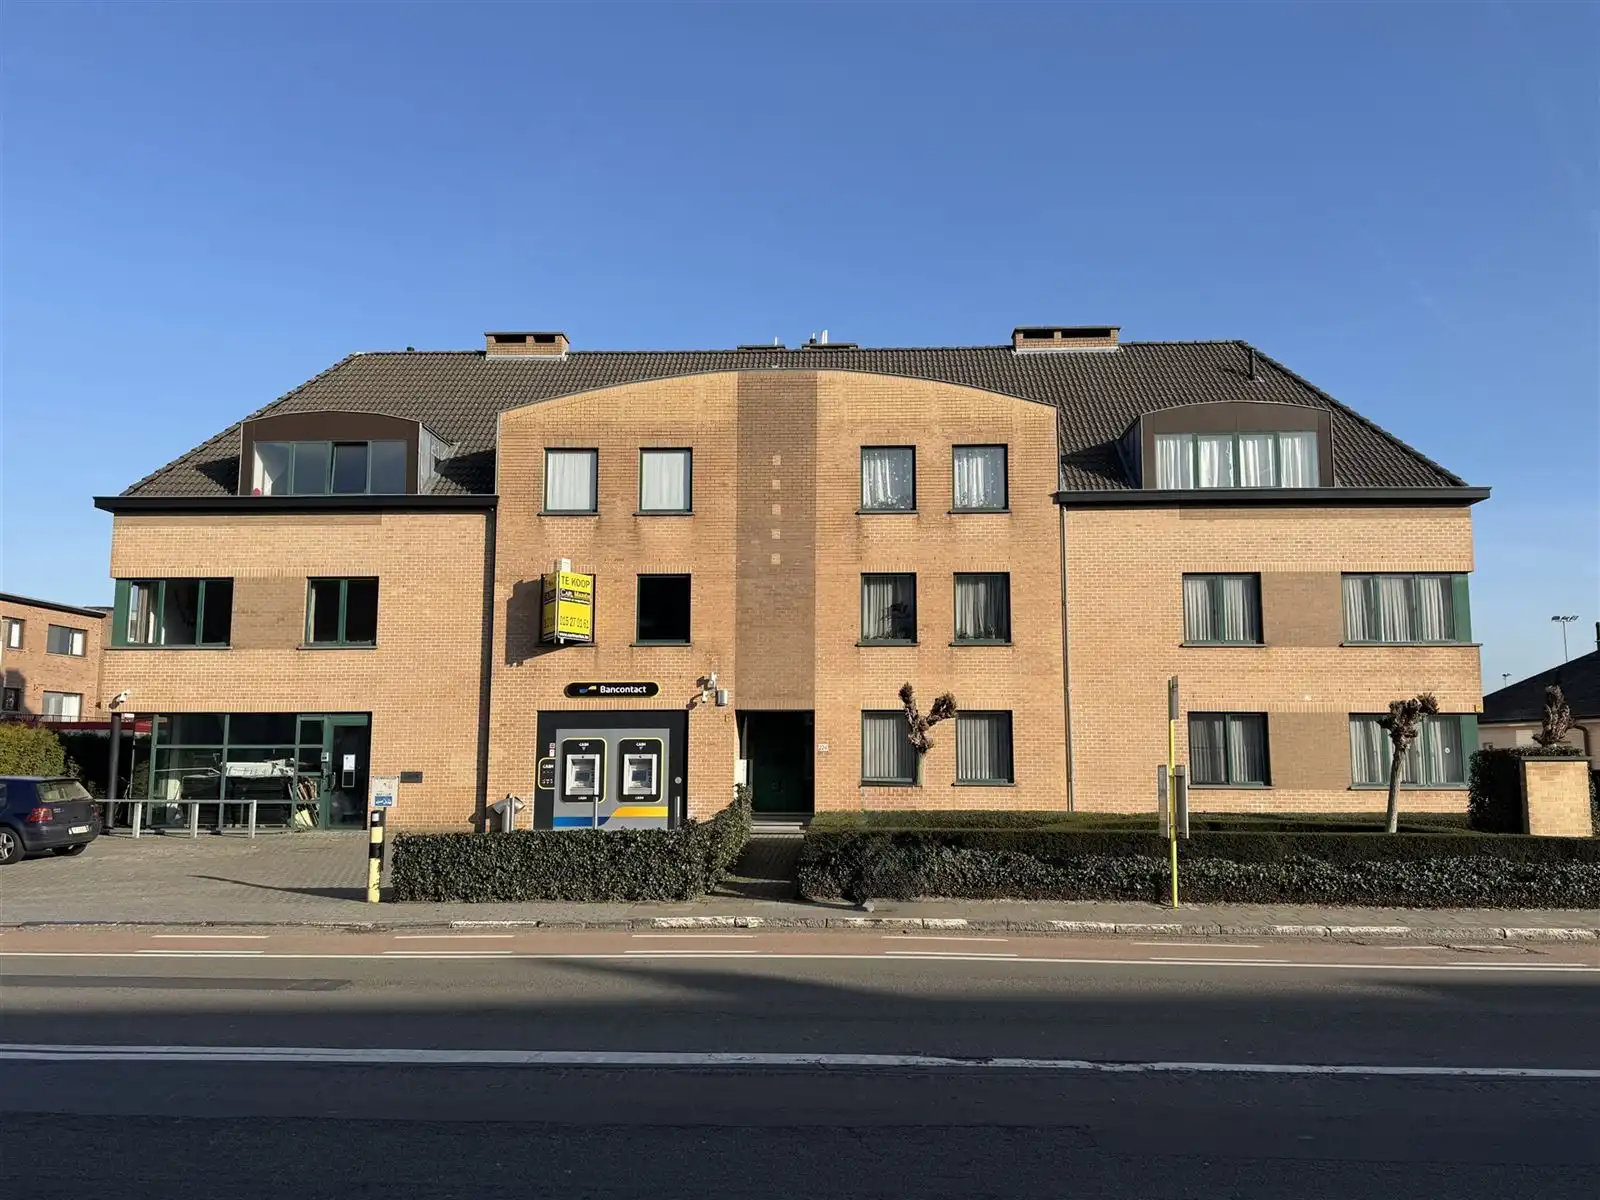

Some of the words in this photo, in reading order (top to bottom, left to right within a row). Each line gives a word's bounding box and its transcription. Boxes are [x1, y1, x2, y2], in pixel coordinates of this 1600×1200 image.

[561, 576, 570, 585] TE
[571, 578, 590, 588] KOOP
[600, 685, 647, 694] Bancontact
